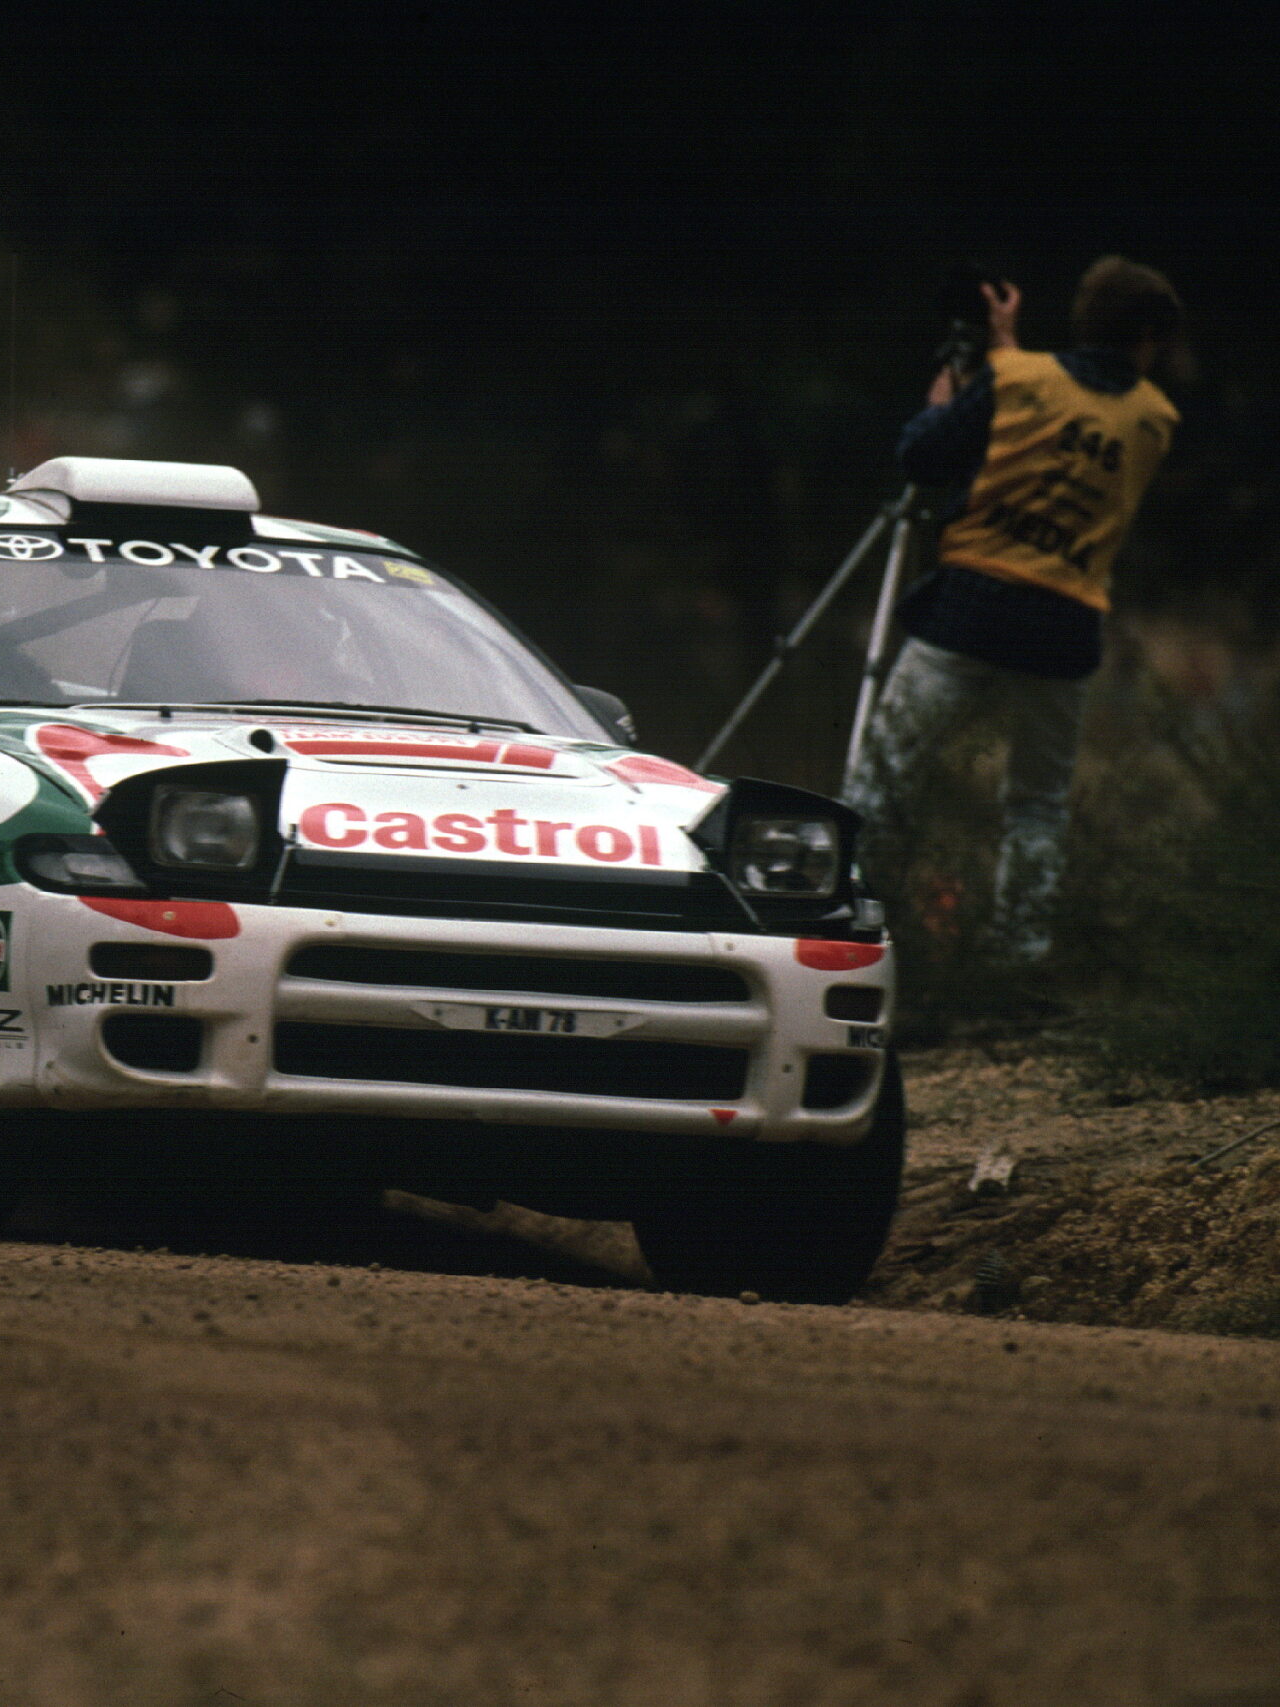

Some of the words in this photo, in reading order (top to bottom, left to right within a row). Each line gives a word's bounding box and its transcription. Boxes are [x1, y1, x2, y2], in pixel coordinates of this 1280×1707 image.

[67, 538, 386, 584] TOYOTA
[299, 802, 662, 867] Castrol
[46, 983, 175, 1007] MICHELIN
